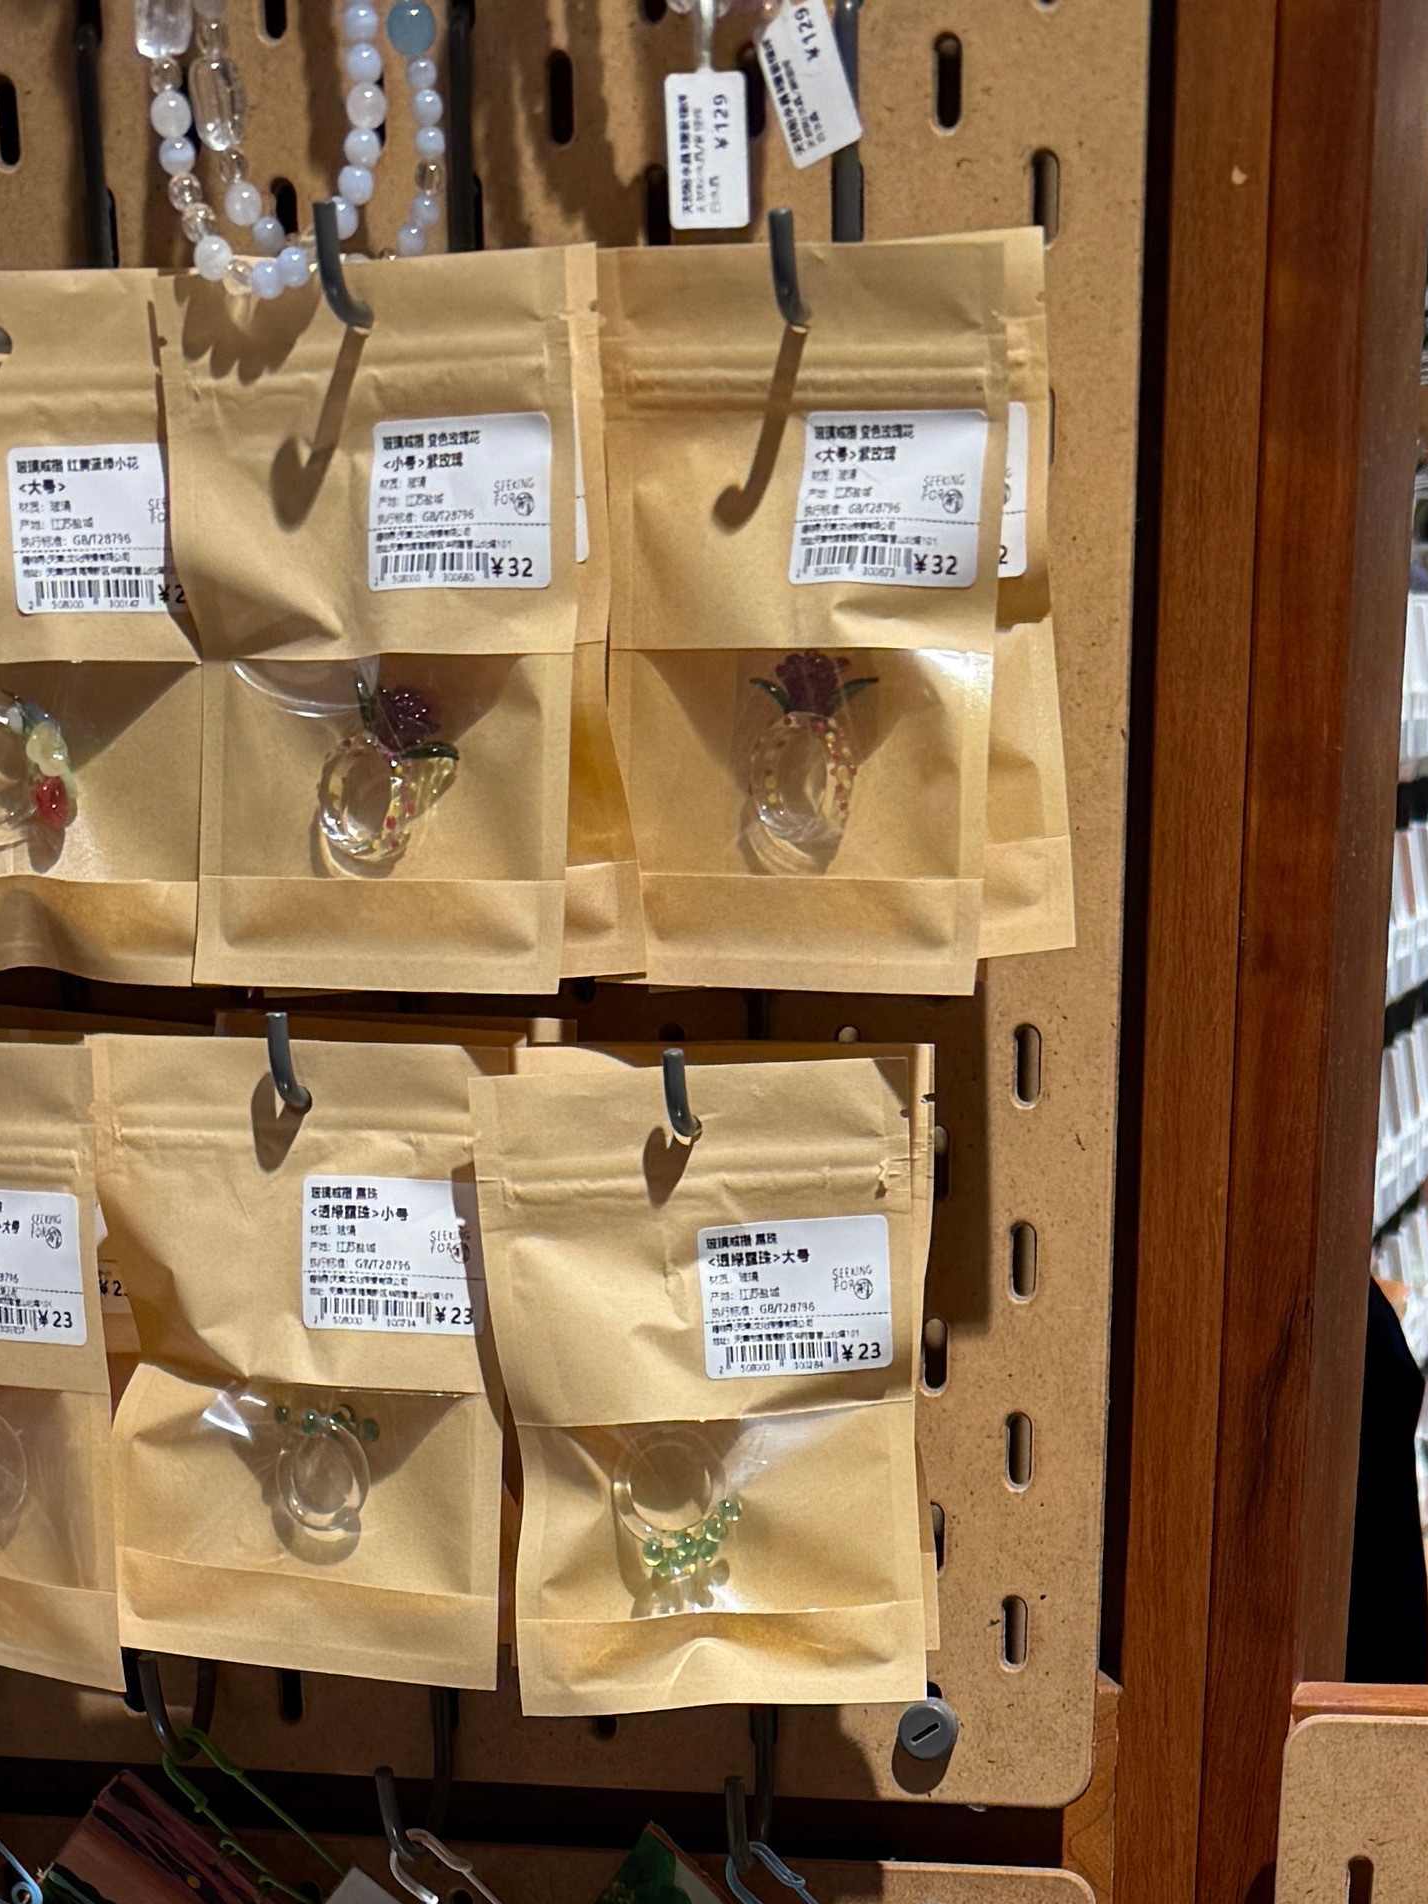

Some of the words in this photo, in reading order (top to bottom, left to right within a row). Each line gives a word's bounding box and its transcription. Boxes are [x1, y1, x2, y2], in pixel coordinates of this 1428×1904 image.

[713, 93, 729, 149] ¥129
[18, 479, 66, 496] <大号>
[490, 557, 534, 578] ¥32
[913, 553, 958, 576] ¥32
[832, 1266, 872, 1280] SEEKING
[38, 1309, 73, 1329] ¥23
[435, 1306, 473, 1325] ¥23
[842, 1342, 882, 1362] ¥23
